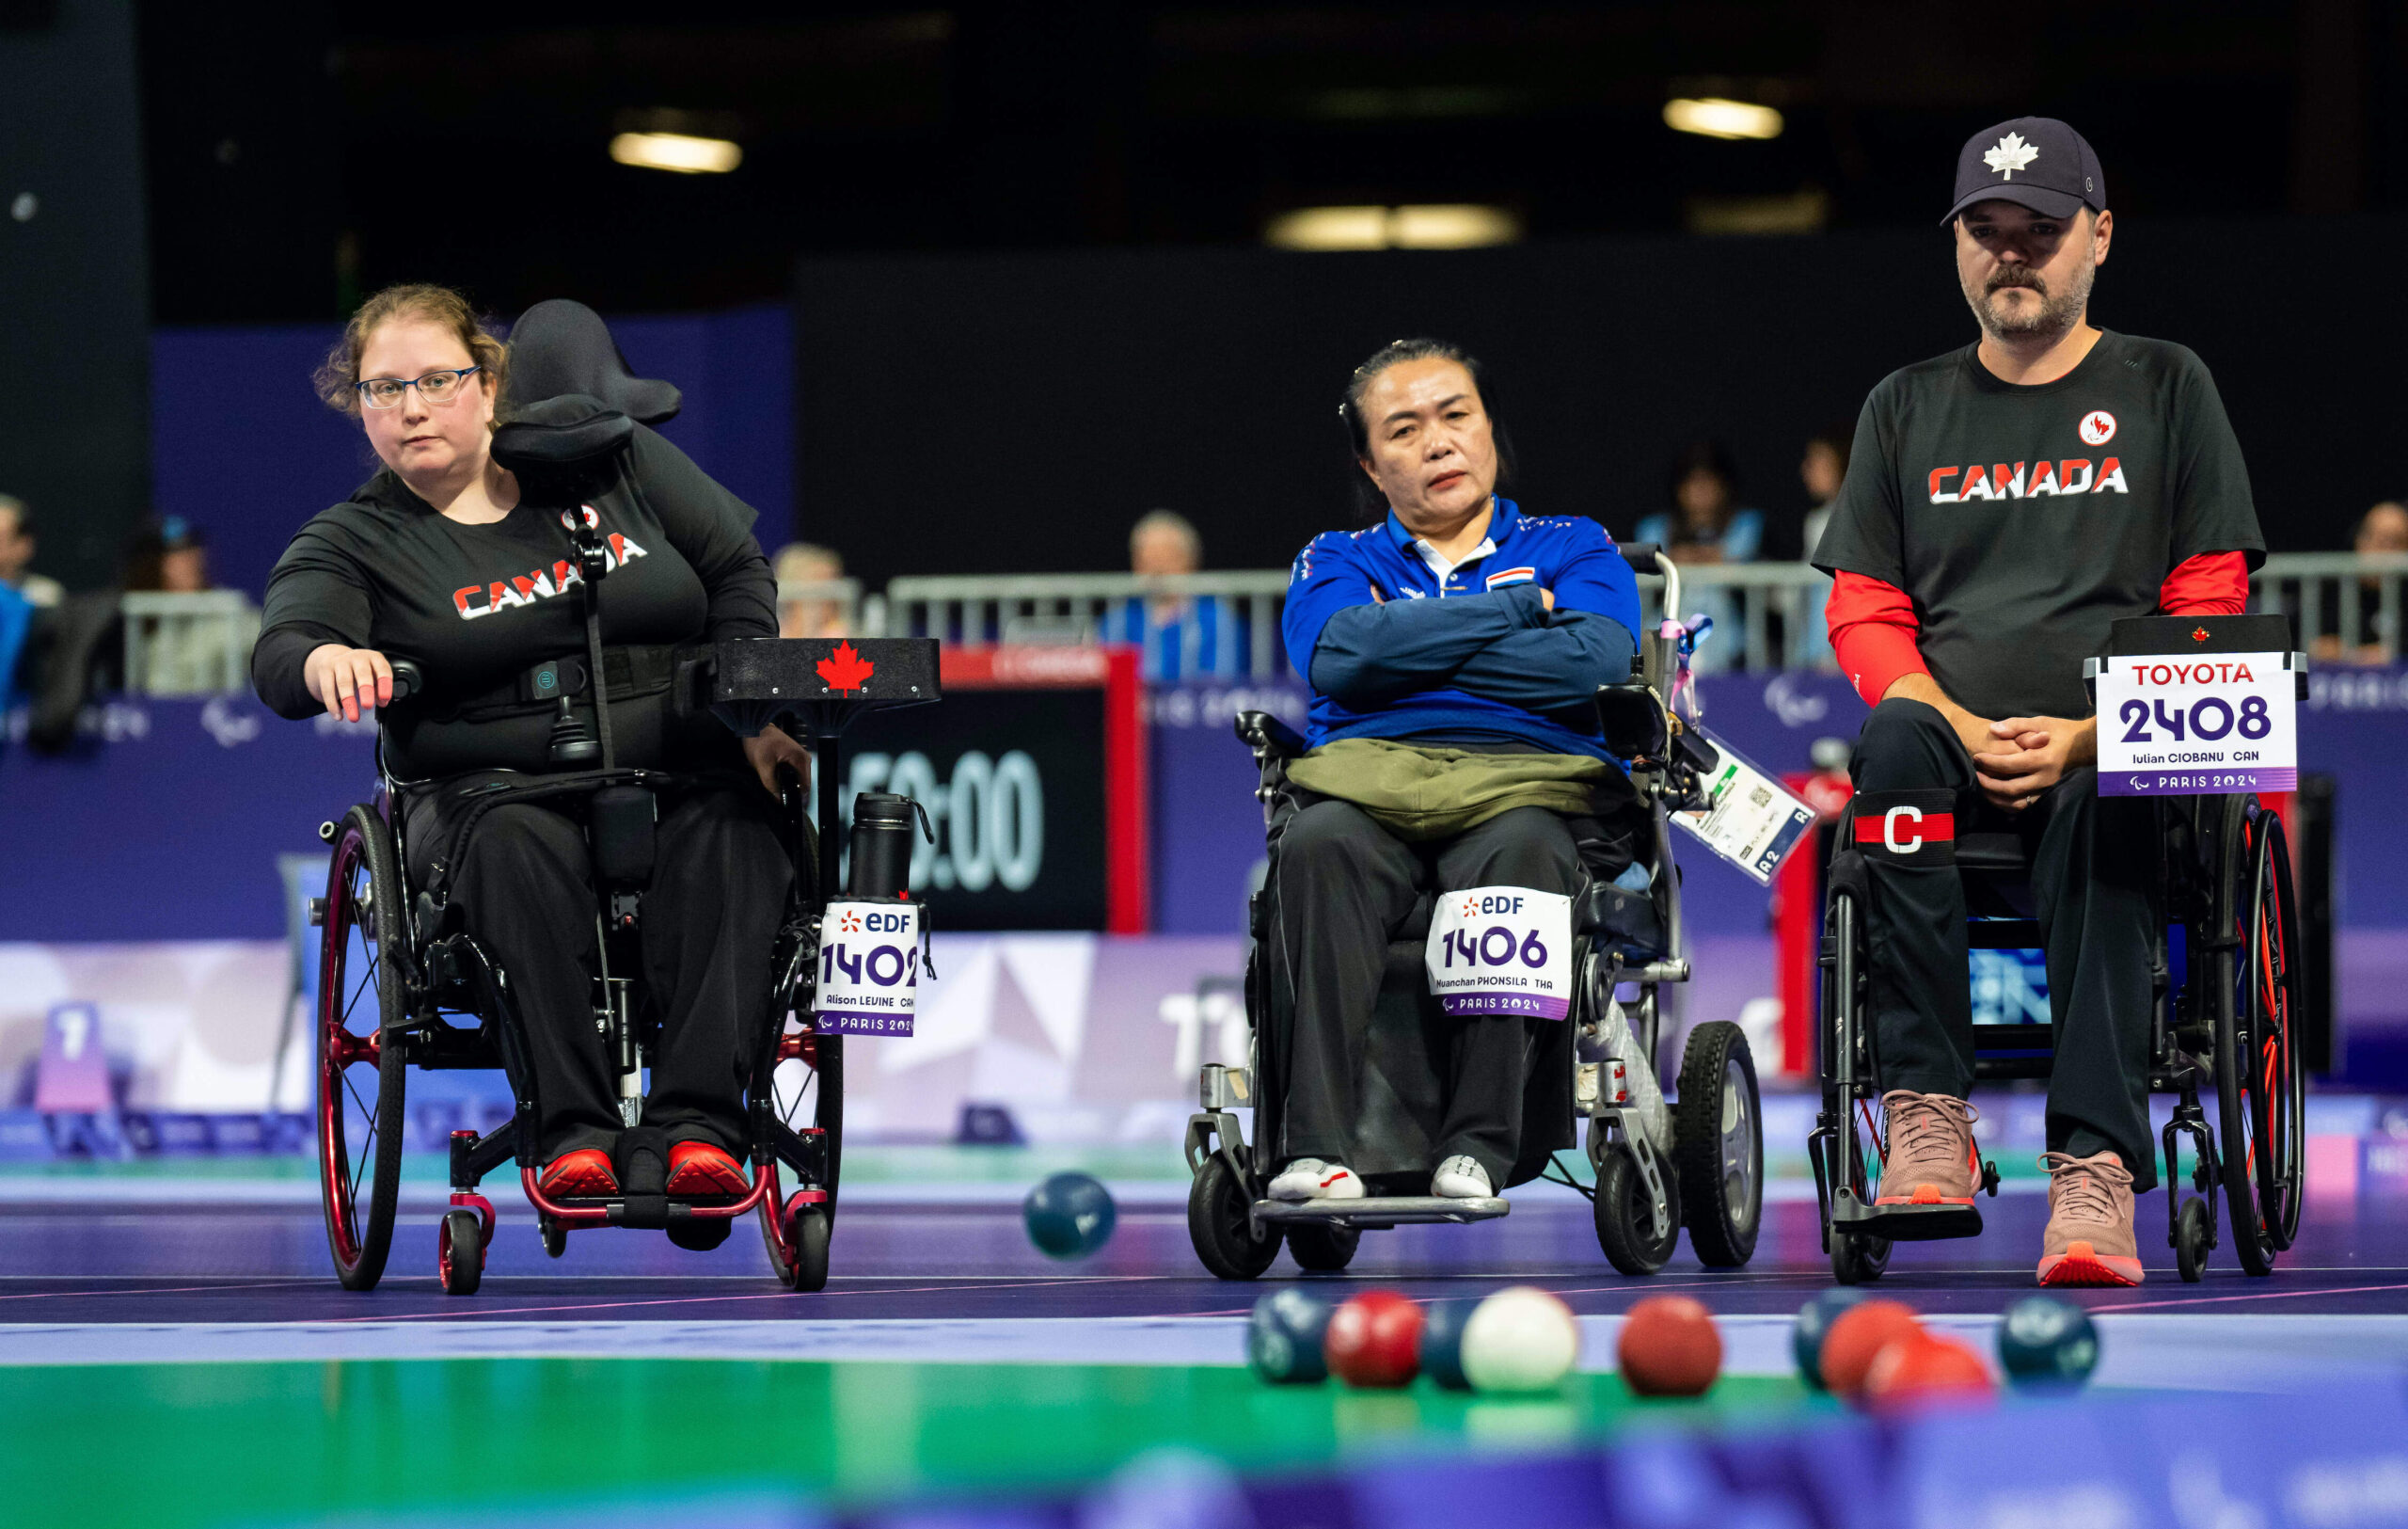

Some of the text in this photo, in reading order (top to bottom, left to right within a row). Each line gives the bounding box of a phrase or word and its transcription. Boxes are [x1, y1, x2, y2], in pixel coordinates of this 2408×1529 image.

[1929, 457, 2129, 504] CANADA
[452, 532, 648, 621] CANAA
[2131, 662, 2255, 686] TOYOTA
[2119, 695, 2272, 743] 2408
[2132, 751, 2259, 764] Iulian CIOBANU CAN
[2159, 774, 2258, 788] PARIS 2024
[1884, 806, 1923, 854] C
[1443, 926, 1548, 968] 1406
[1477, 977, 1528, 987] PHONSILA
[1535, 979, 1553, 990] THA
[826, 995, 857, 1005] Alison
[860, 995, 894, 1007] LEVINE
[1460, 997, 1540, 1011] PARIS 2024
[840, 1017, 884, 1030] PARIS
